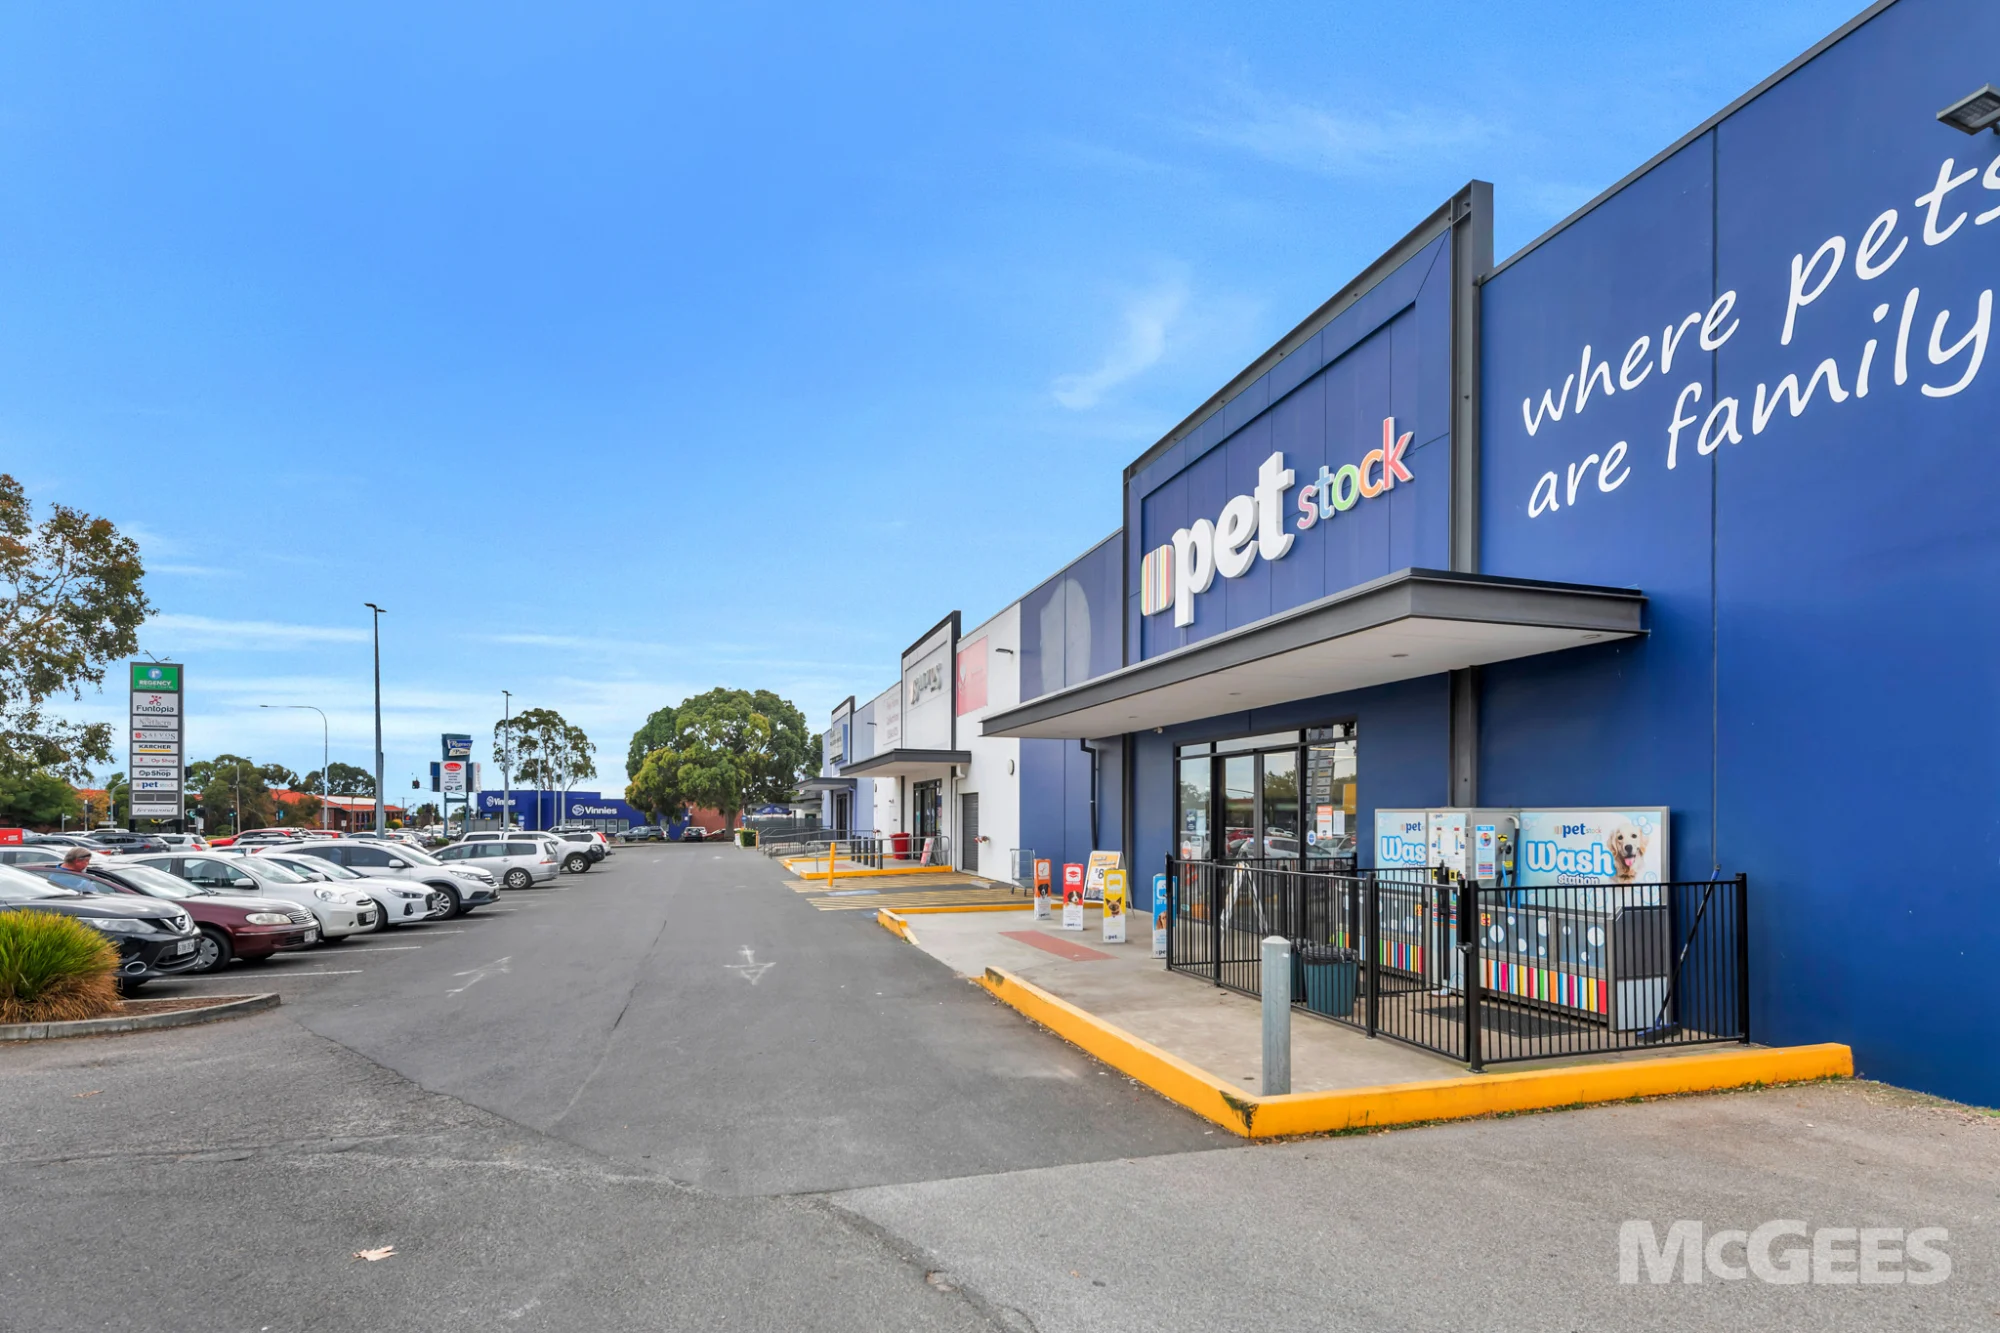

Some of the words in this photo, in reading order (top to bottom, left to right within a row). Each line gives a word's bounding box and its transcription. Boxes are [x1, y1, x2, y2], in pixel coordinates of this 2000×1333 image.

[1522, 290, 1740, 436] where
[1780, 157, 2000, 345] pets
[1527, 440, 1631, 518] are
[1666, 287, 1993, 469] family
[1172, 451, 1295, 628] pet
[1297, 417, 1414, 530] stock
[136, 704, 174, 713] Funtopia
[494, 798, 516, 806] Vines
[585, 806, 617, 815] Vinnies
[1406, 822, 1421, 833] pet
[1562, 823, 1586, 838] pet
[1586, 825, 1602, 834] stock
[1382, 836, 1426, 862] Was
[1527, 841, 1615, 877] Wash
[1557, 873, 1600, 886] station
